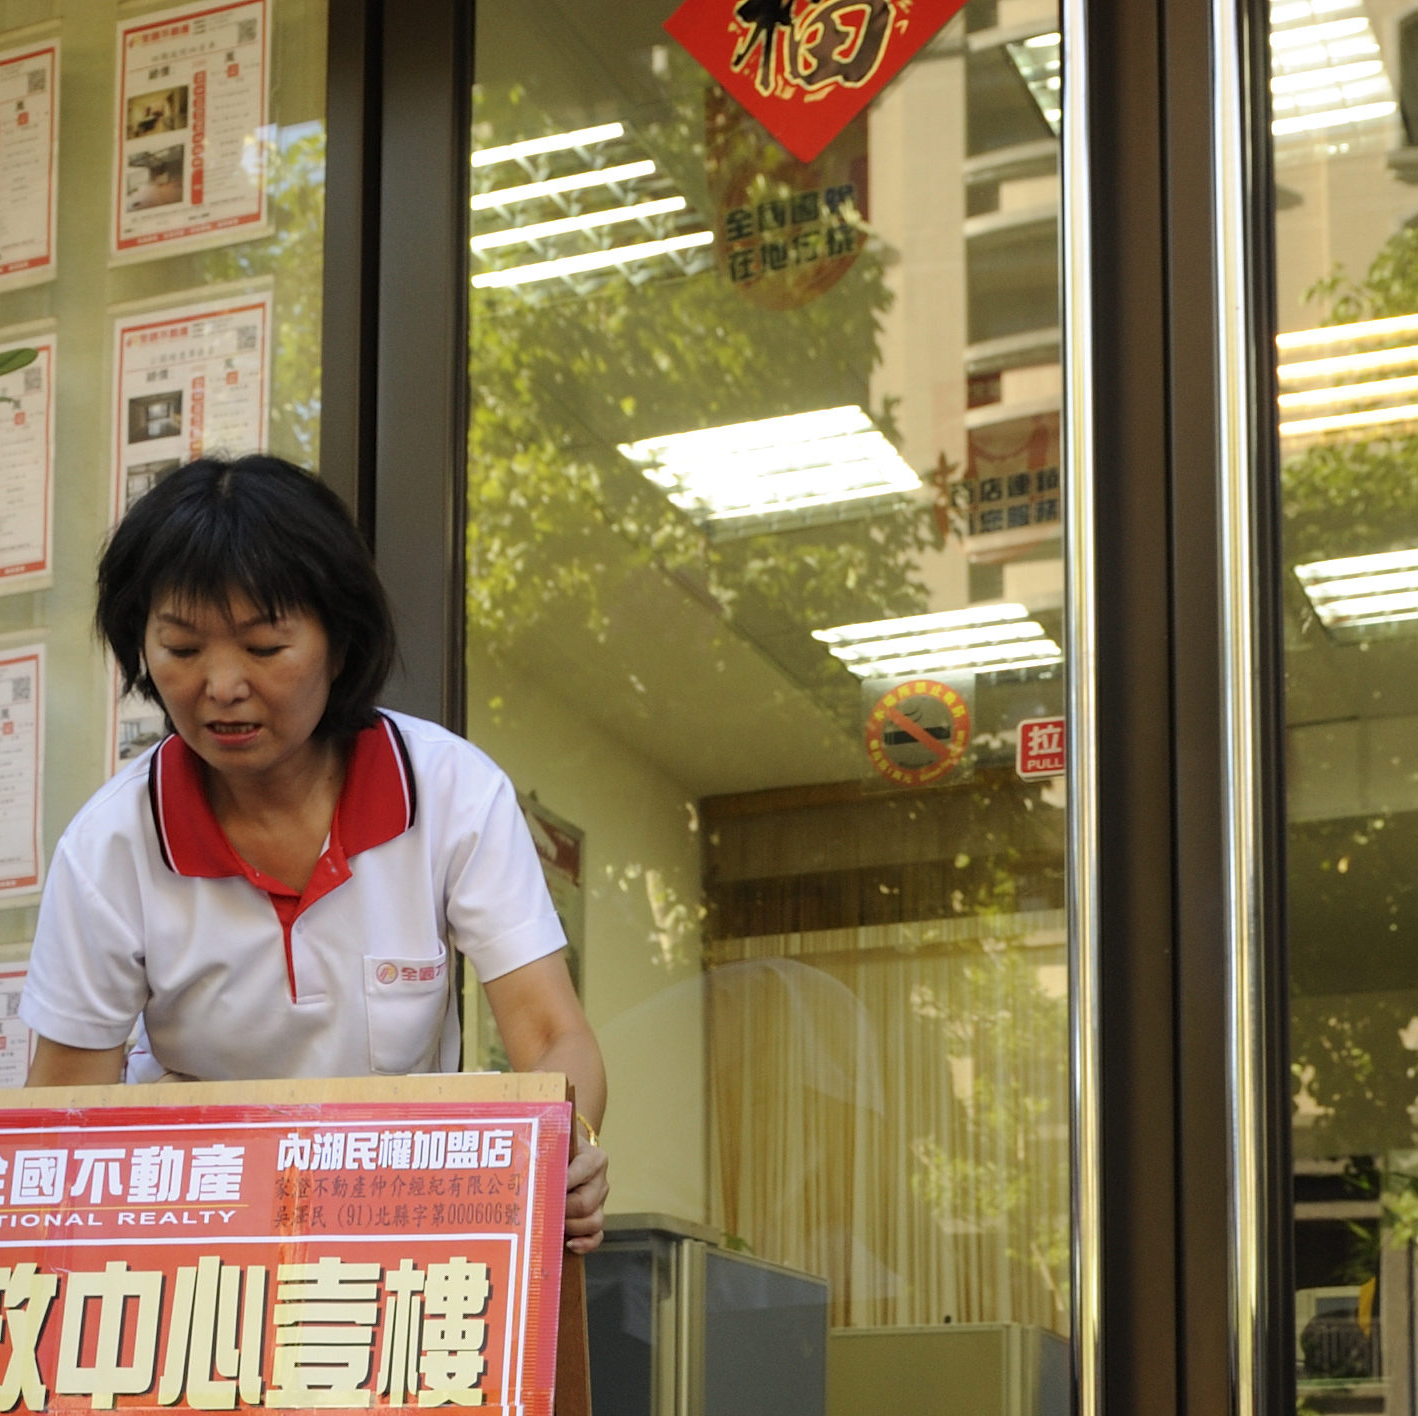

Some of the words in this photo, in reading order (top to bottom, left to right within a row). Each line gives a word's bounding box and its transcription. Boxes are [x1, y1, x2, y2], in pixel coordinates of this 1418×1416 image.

[1028, 724, 1062, 756] 拉
[1026, 758, 1063, 770] PULL
[276, 1129, 515, 1171] 內湖民權加盟店
[117, 1208, 237, 1227] REALTY
